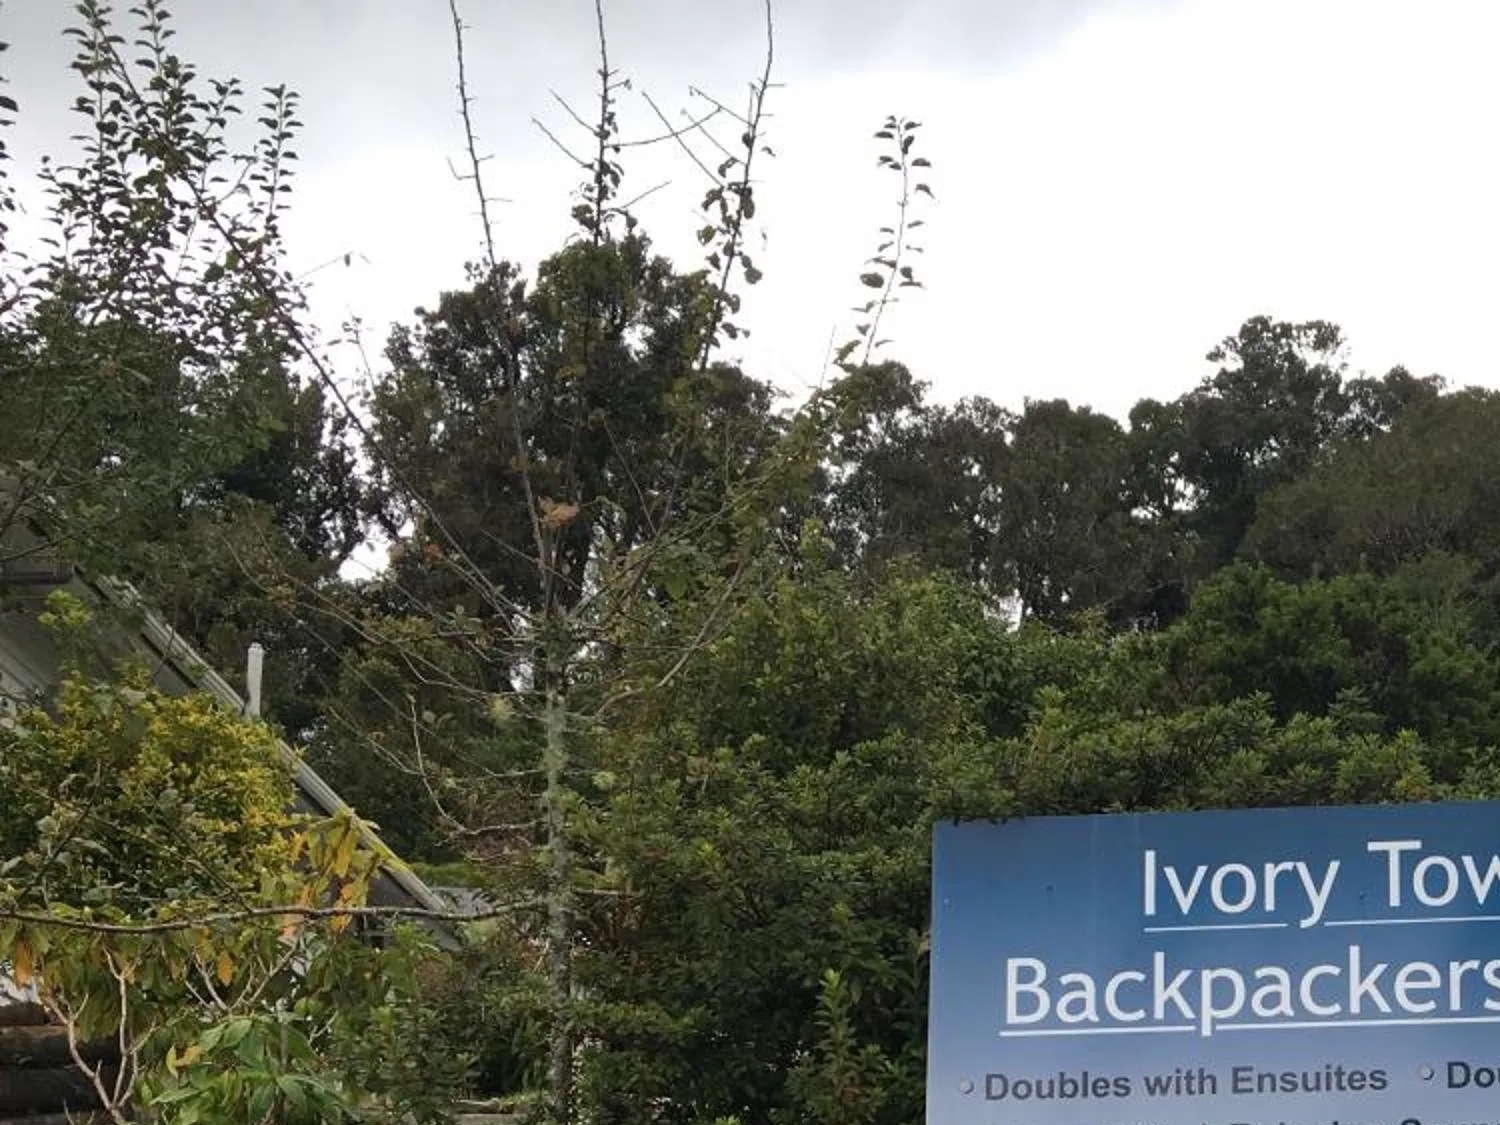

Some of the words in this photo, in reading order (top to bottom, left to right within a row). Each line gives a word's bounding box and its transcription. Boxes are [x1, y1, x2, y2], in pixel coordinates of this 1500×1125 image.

[1143, 849, 1340, 928] Ivory
[984, 1072, 1131, 1101] Doubles
[1143, 1068, 1217, 1097] with
[1231, 1065, 1387, 1095] Ensuites
